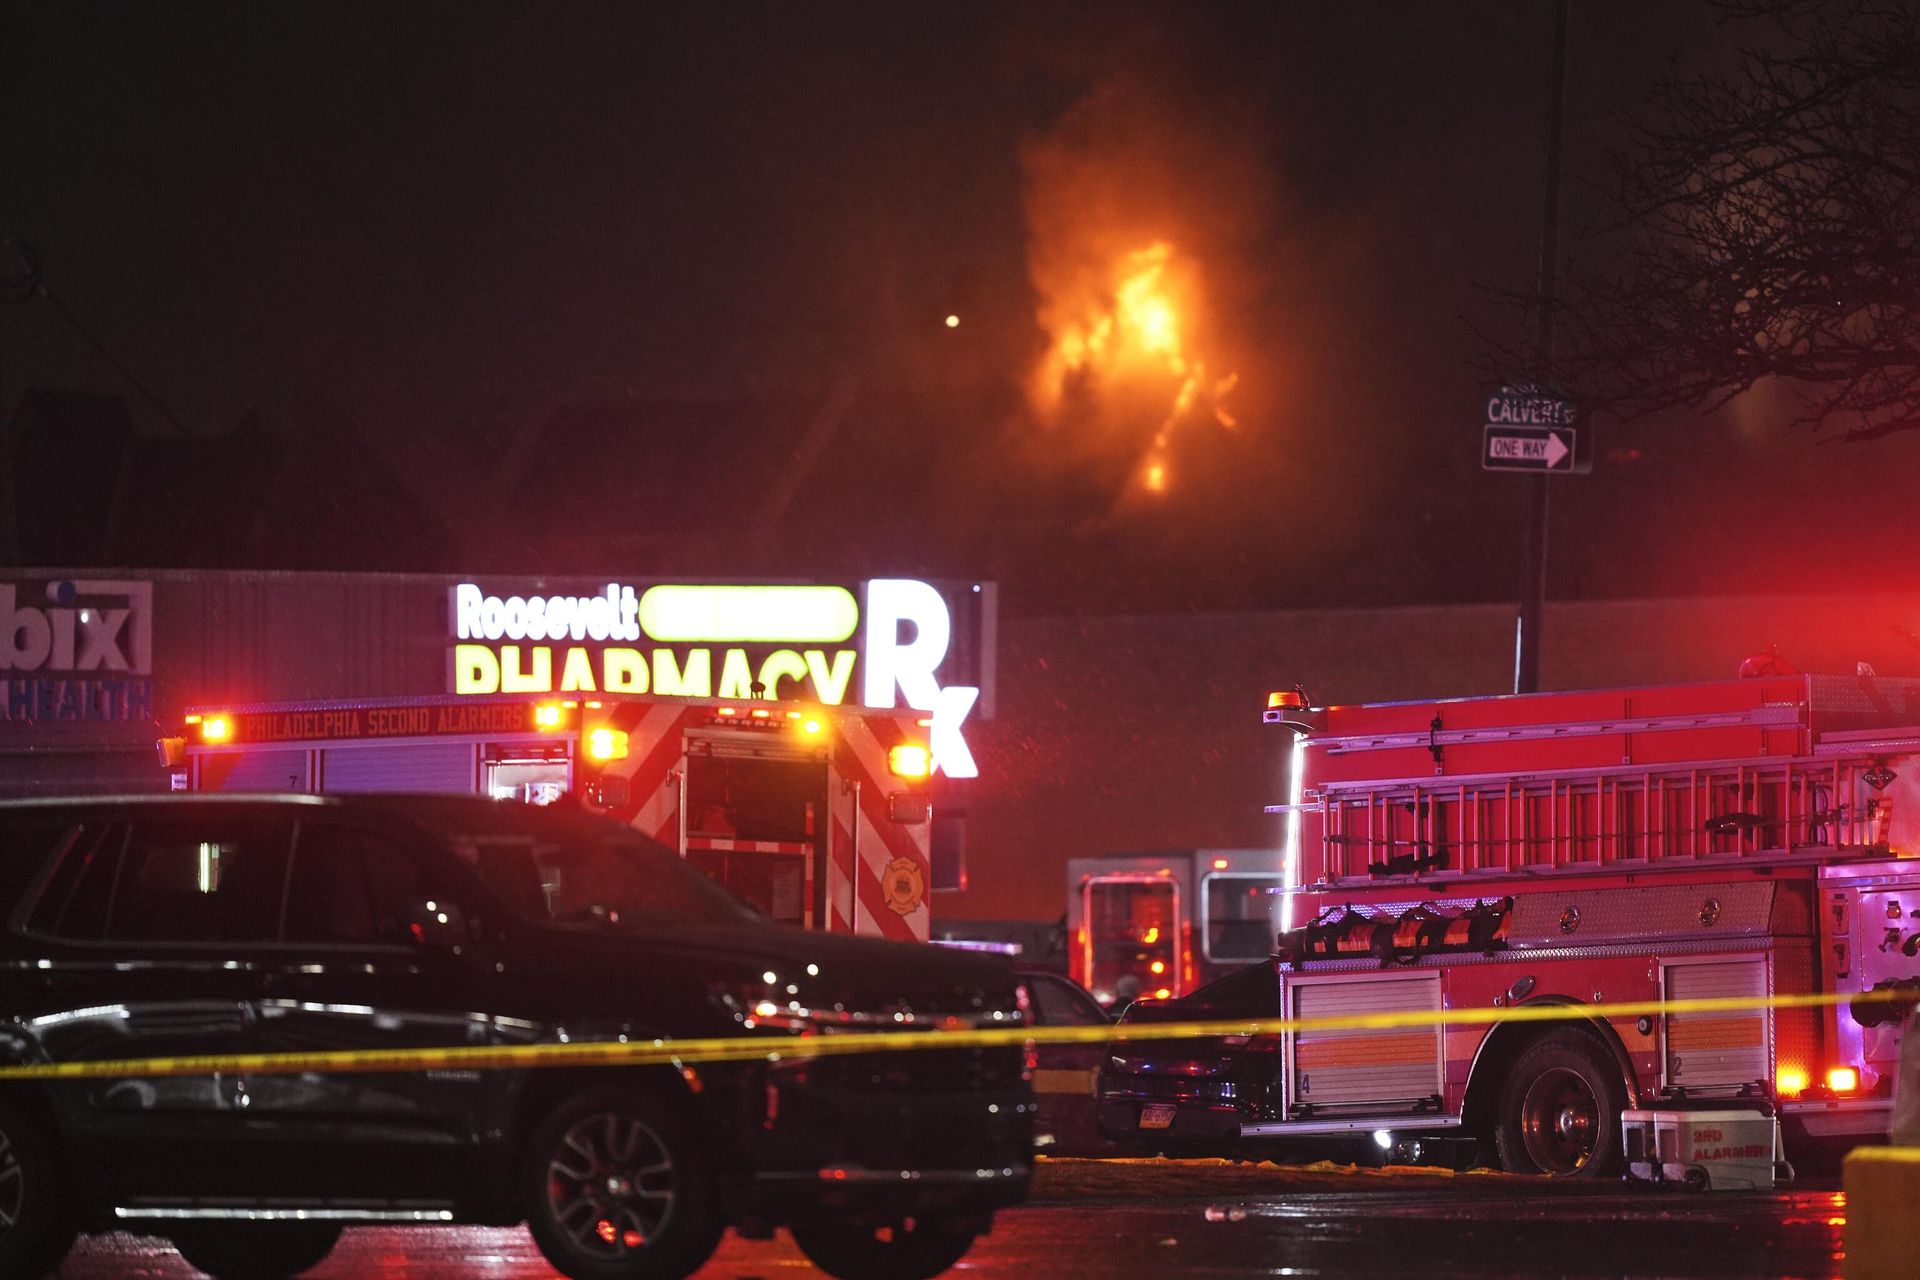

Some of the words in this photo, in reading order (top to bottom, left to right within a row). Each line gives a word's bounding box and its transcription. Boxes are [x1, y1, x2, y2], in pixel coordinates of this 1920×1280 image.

[1495, 439, 1518, 456] ONE
[1523, 440, 1548, 457] WAY
[456, 583, 640, 641] Roosevelt
[8, 679, 152, 721] HEALTH
[246, 710, 360, 740] PHILADELPHIA
[367, 706, 431, 737] SECOND
[437, 704, 524, 733] ALARMERS
[288, 775, 298, 788] 7
[1672, 1056, 1682, 1077] 2
[1302, 1074, 1310, 1094] 4
